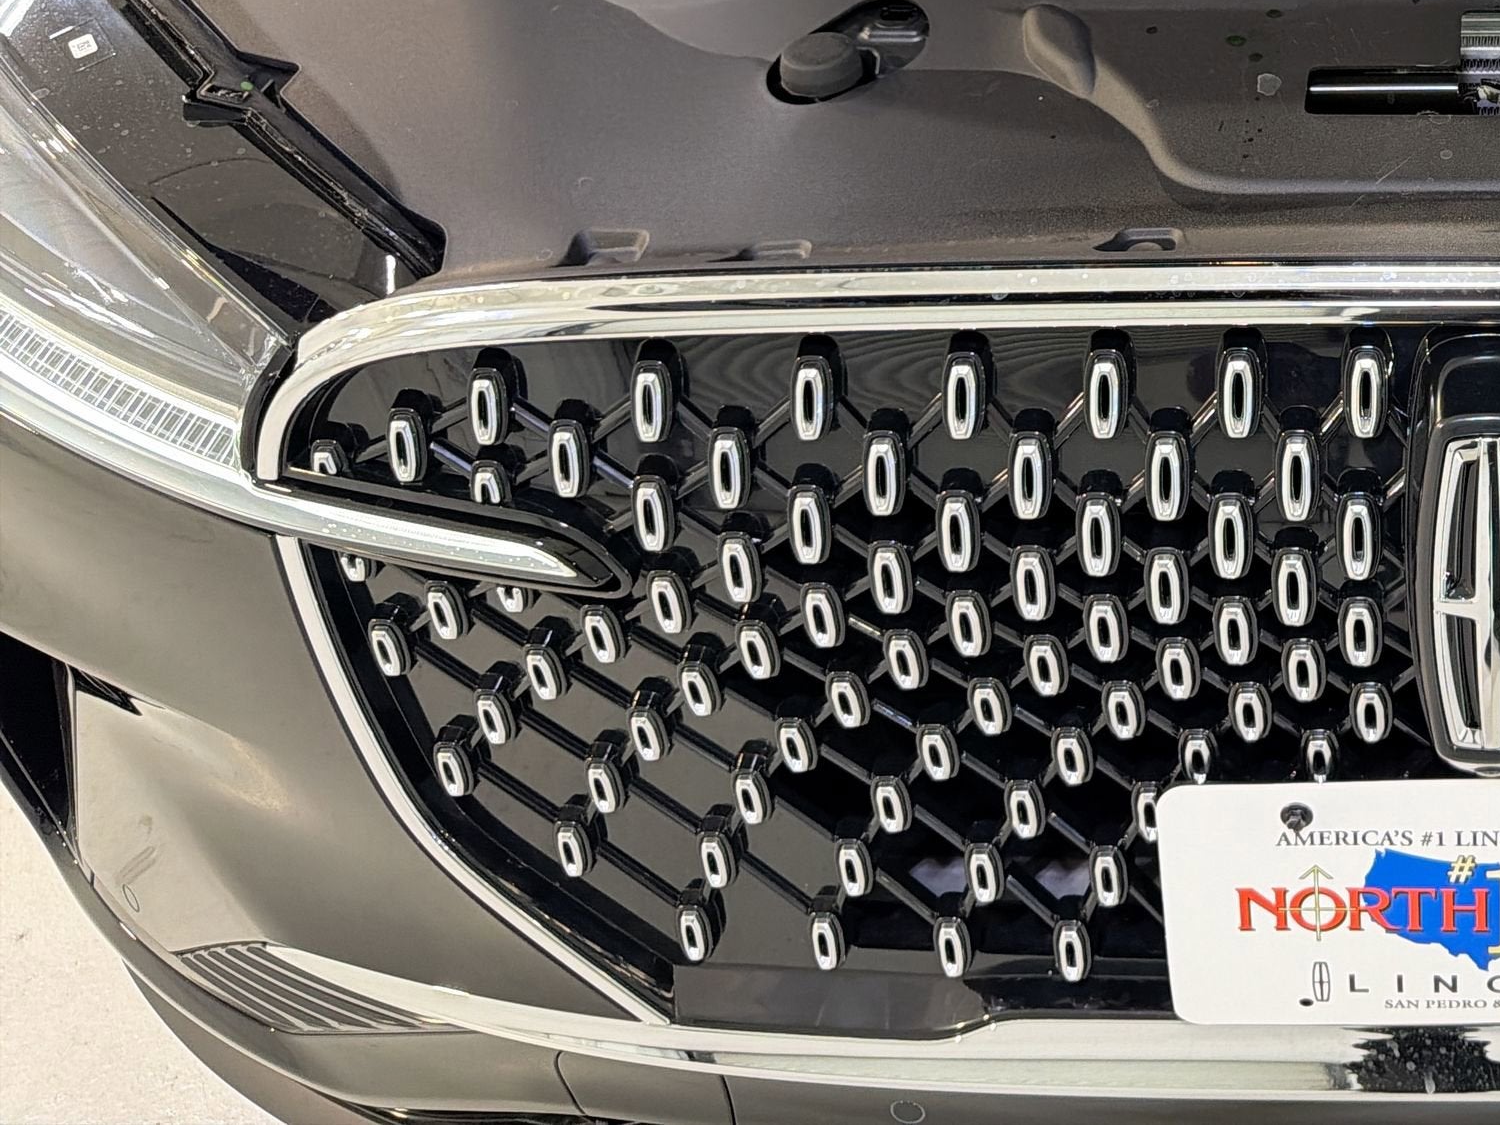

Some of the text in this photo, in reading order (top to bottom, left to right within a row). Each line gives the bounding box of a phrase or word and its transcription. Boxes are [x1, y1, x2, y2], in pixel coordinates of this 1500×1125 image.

[1275, 829, 1414, 847] AMERICA'S
[1420, 830, 1447, 847] #1
[1234, 885, 1491, 933] NORTH
[1384, 998, 1420, 1010] SAN
[1425, 998, 1488, 1010] PEDRO
